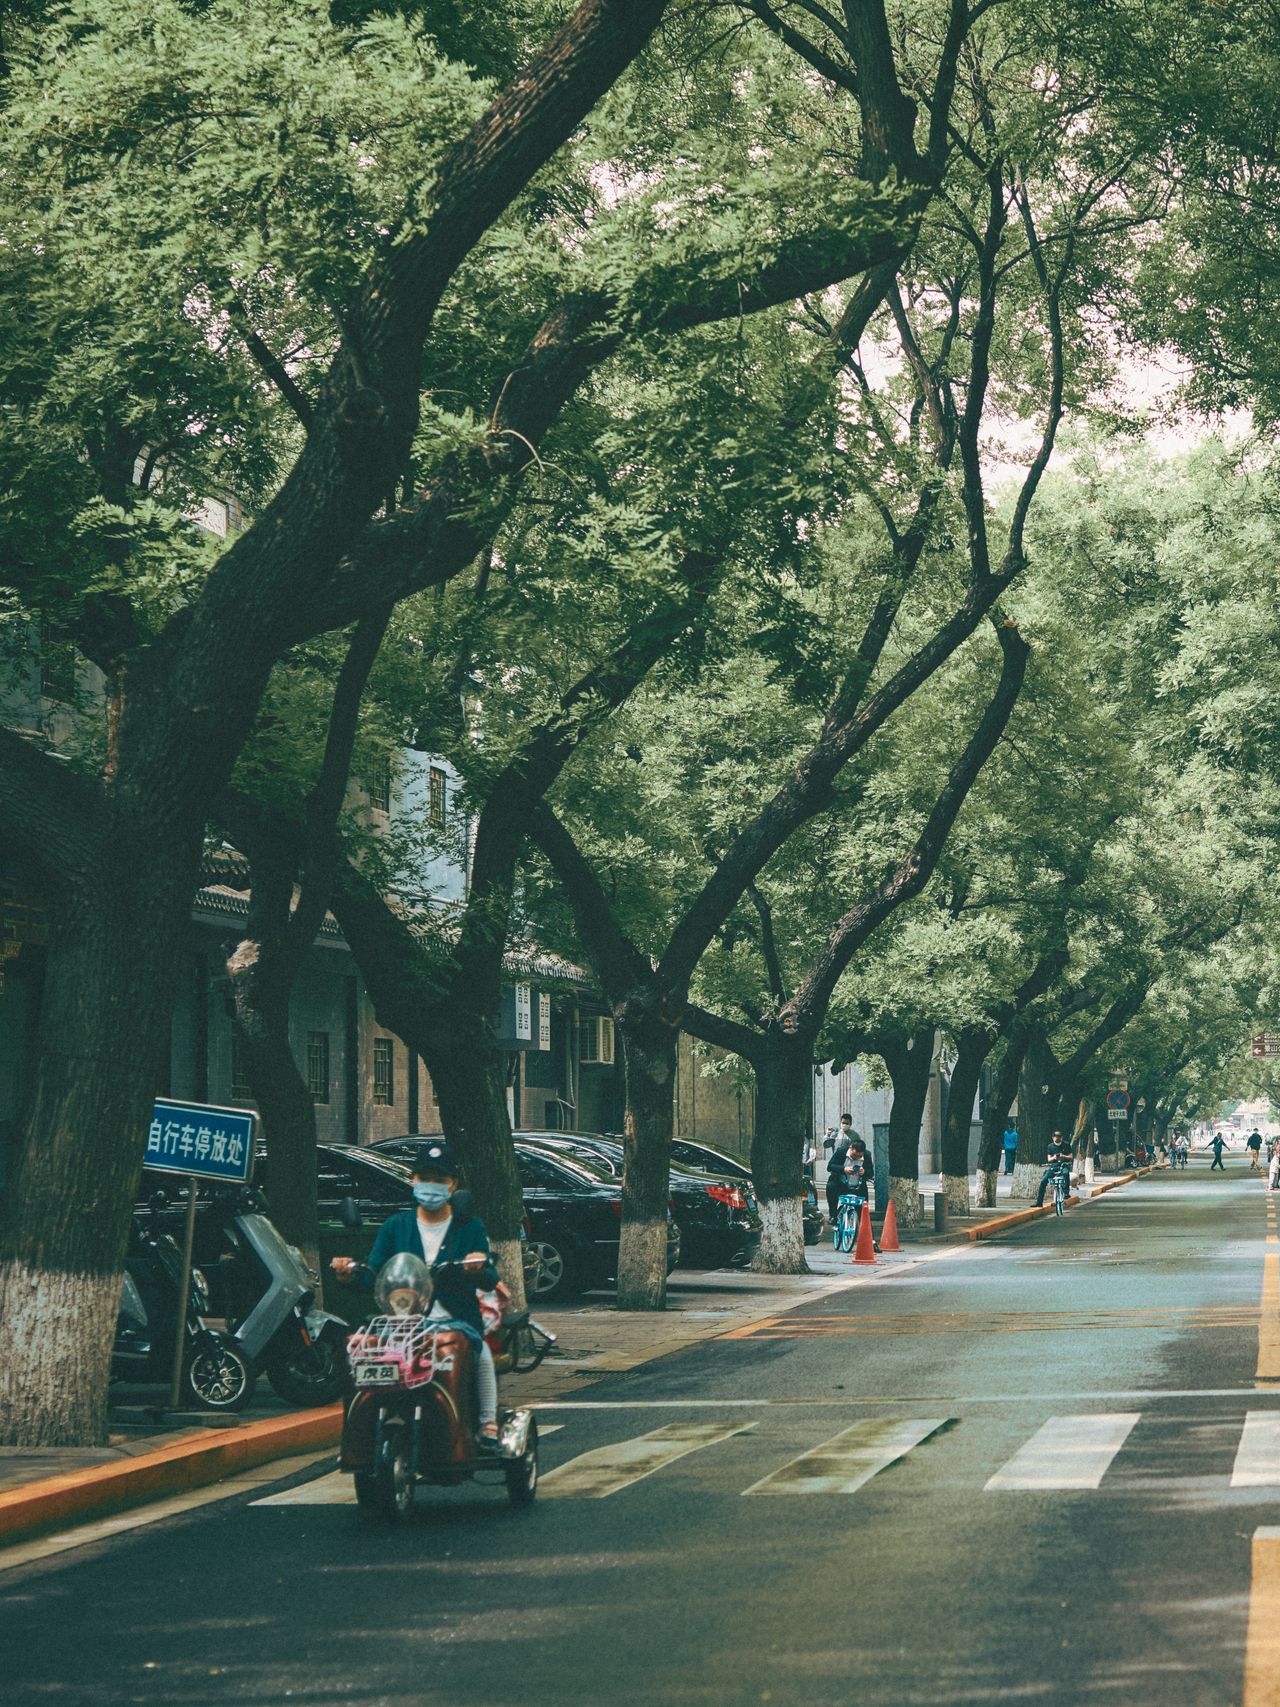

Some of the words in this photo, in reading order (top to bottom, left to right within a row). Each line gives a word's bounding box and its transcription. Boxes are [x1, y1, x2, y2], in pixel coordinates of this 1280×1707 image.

[147, 1118, 243, 1166] 自行车停放处
